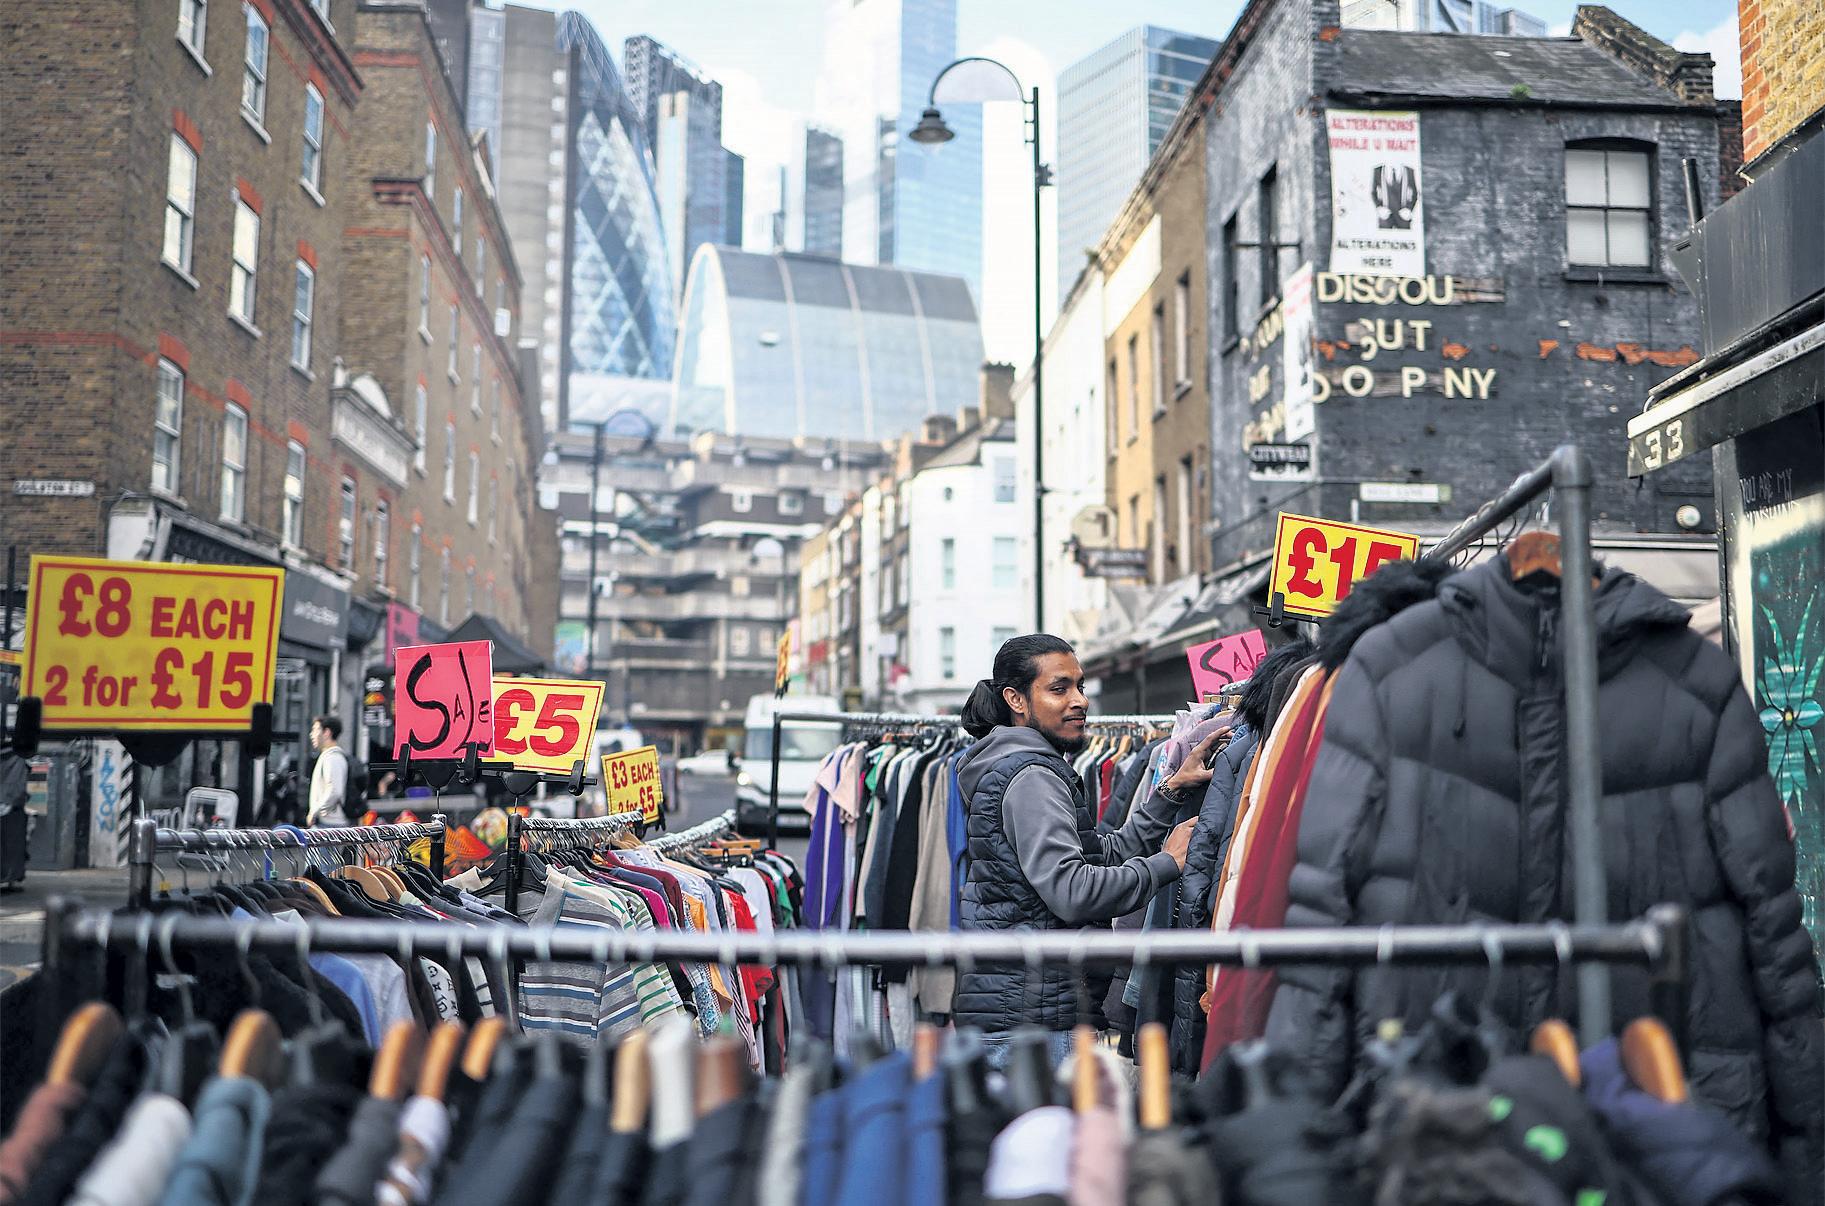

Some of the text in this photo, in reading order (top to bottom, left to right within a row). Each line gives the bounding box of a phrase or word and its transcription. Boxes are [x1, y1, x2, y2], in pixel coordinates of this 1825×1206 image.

[1329, 136, 1416, 151] WHILE U WAIT
[1644, 418, 1684, 469] 33
[58, 572, 132, 638] £8
[151, 596, 255, 641] EACH
[44, 647, 254, 710] 2 for £15
[493, 688, 586, 757] £5
[611, 760, 654, 789] £3 EACH
[639, 785, 655, 814] £5
